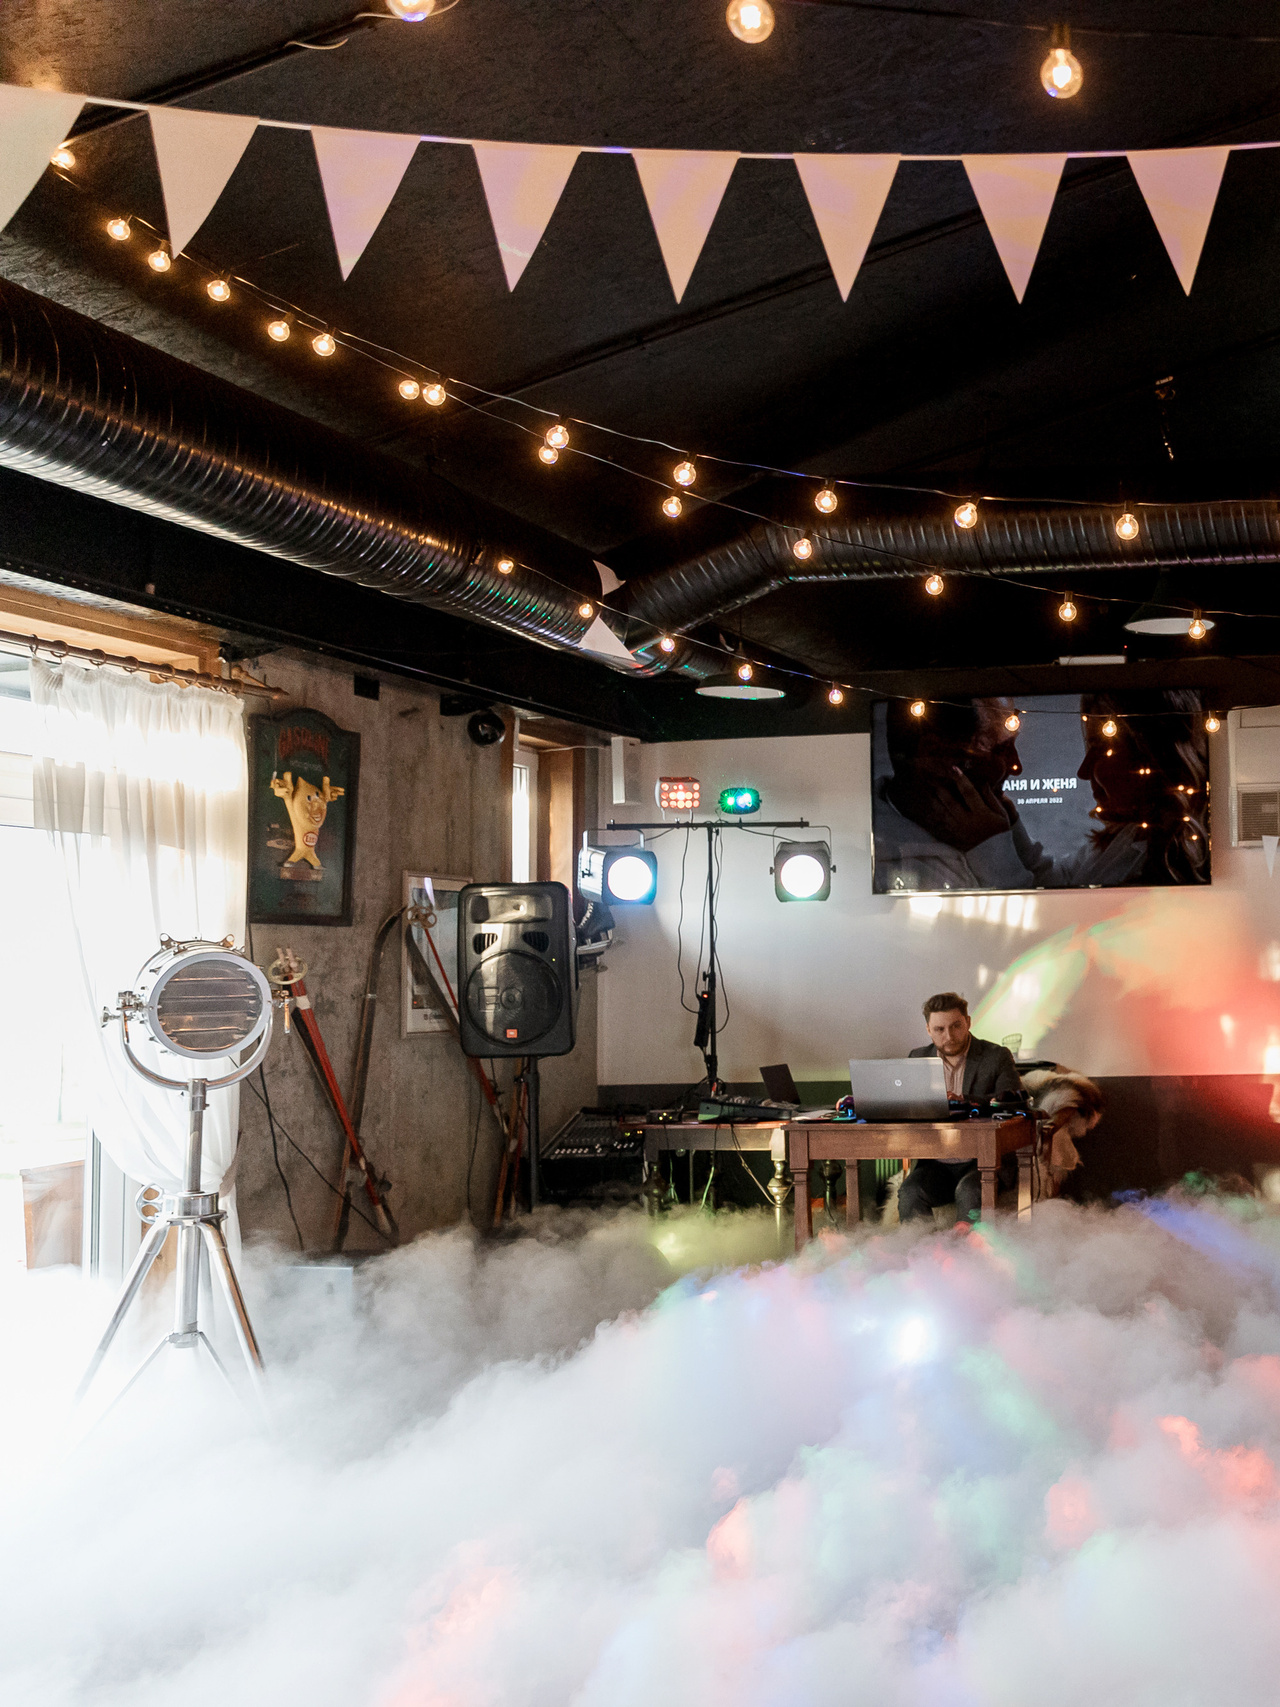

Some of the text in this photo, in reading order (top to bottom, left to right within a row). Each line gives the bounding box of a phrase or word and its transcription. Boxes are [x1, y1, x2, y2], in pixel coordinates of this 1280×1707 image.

[1002, 778, 1077, 791] АНЯ И ЖЕНЯ
